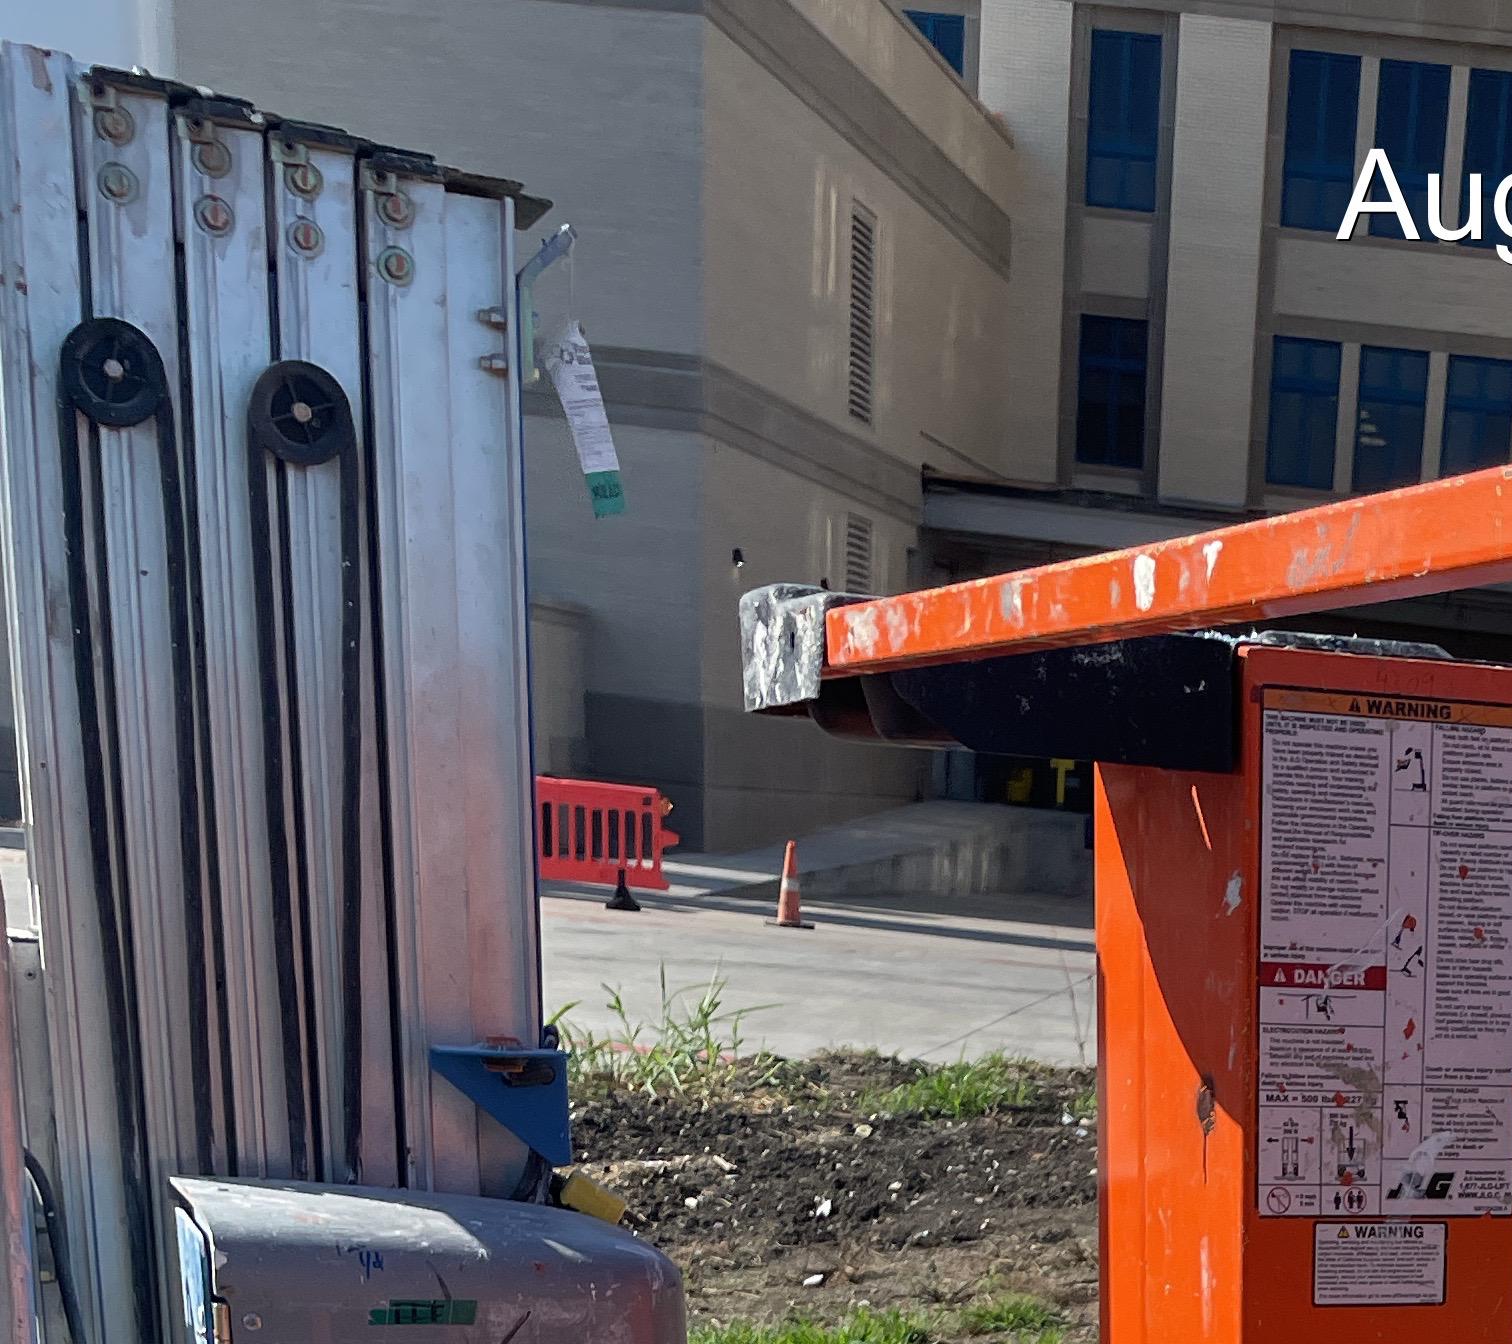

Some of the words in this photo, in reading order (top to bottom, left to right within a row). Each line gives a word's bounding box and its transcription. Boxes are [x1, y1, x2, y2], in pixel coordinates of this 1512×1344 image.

[1366, 699, 1452, 720] WARNING
[1293, 968, 1366, 986] DANGER
[1265, 1094, 1289, 1103] MAX
